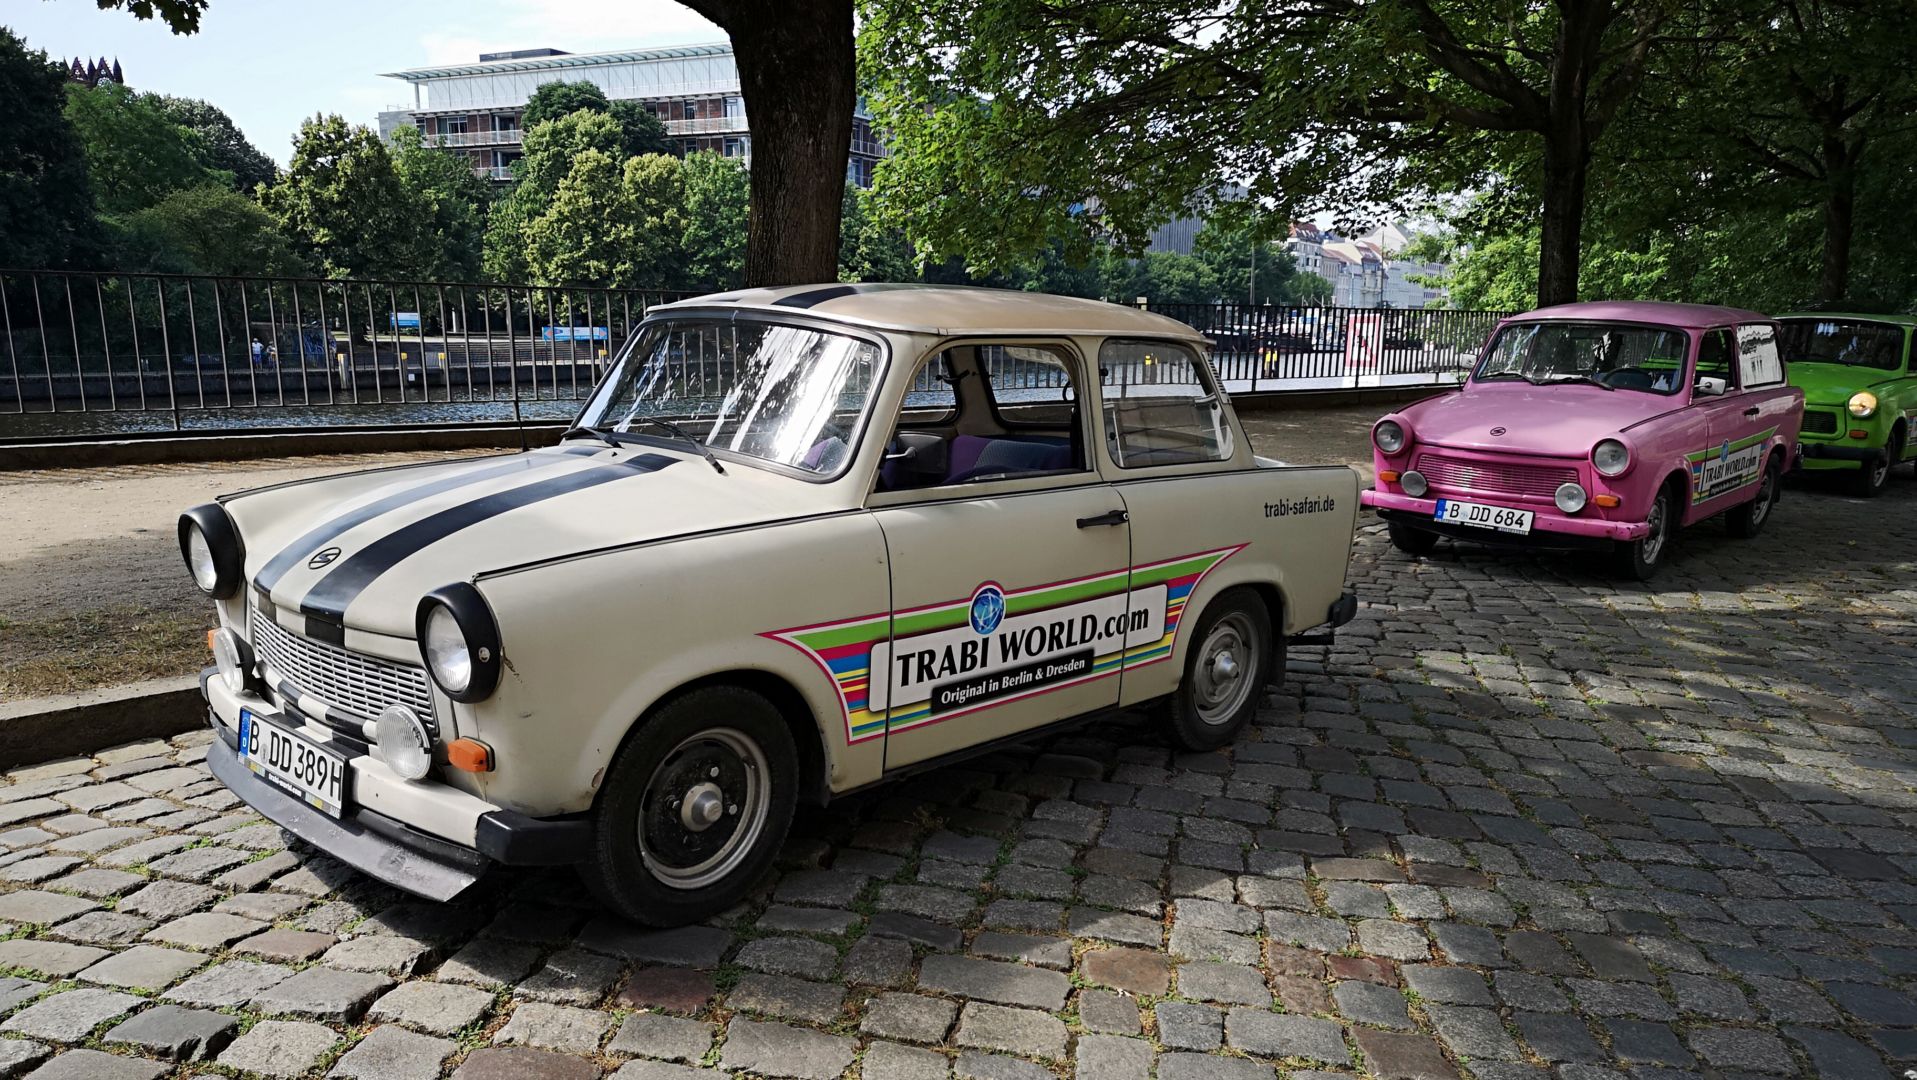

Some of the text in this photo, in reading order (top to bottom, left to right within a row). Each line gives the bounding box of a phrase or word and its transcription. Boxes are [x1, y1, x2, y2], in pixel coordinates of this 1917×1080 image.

[1705, 463, 1725, 483] TRABI
[1264, 495, 1335, 517] trabi-safari.de
[1449, 503, 1460, 518] B
[1469, 506, 1491, 522] DD
[1494, 510, 1525, 528] 684
[896, 607, 1149, 687] TRABI WORLD.com
[941, 658, 1086, 705] Original in Berlin & Dresden
[249, 720, 342, 801] B DD 389H
